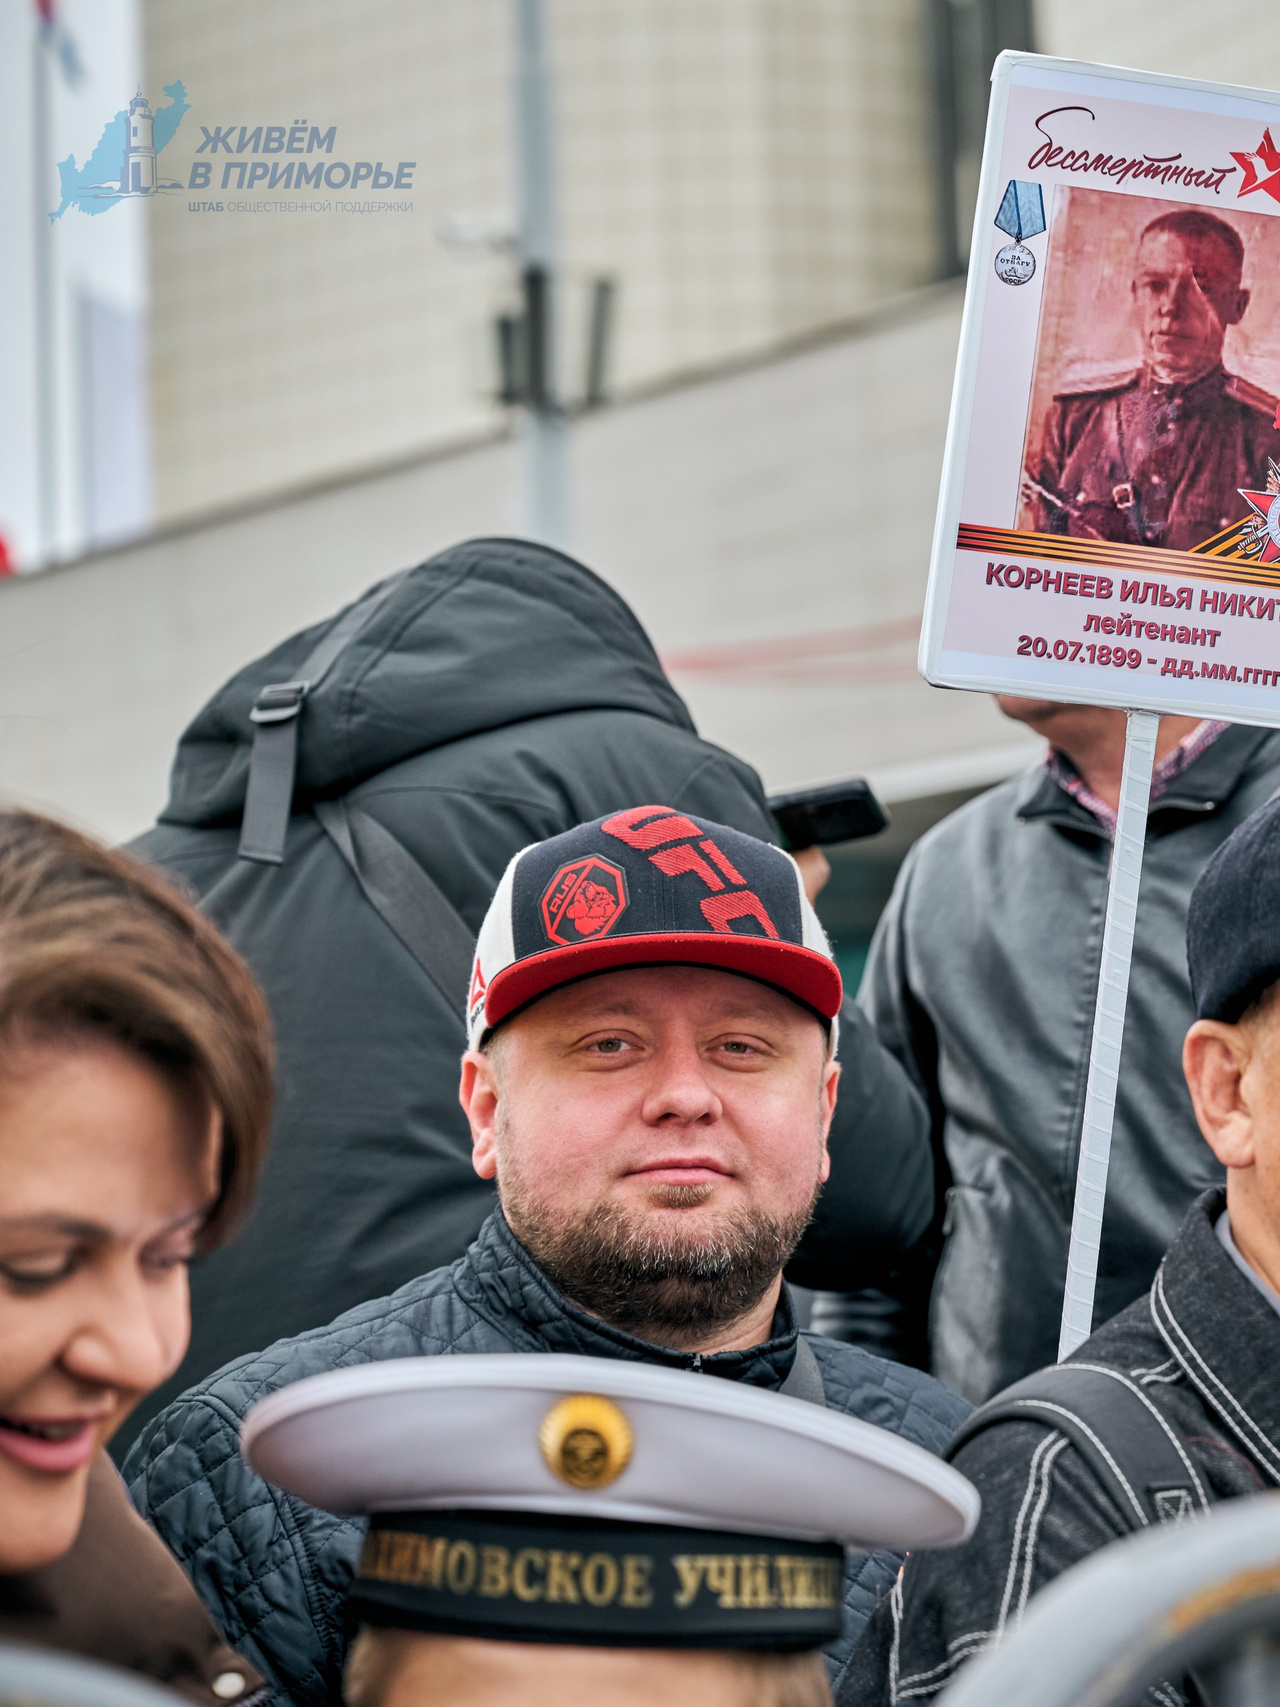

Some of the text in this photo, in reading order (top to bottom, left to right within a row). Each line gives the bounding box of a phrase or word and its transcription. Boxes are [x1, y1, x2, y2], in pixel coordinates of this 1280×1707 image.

[985, 562, 1113, 599] КОРНЕЕВ
[1120, 580, 1190, 610] ИЛЬЯ
[1083, 613, 1221, 648] лейтенант
[1016, 635, 1141, 669] 20.07.1899
[549, 872, 577, 913] RUS
